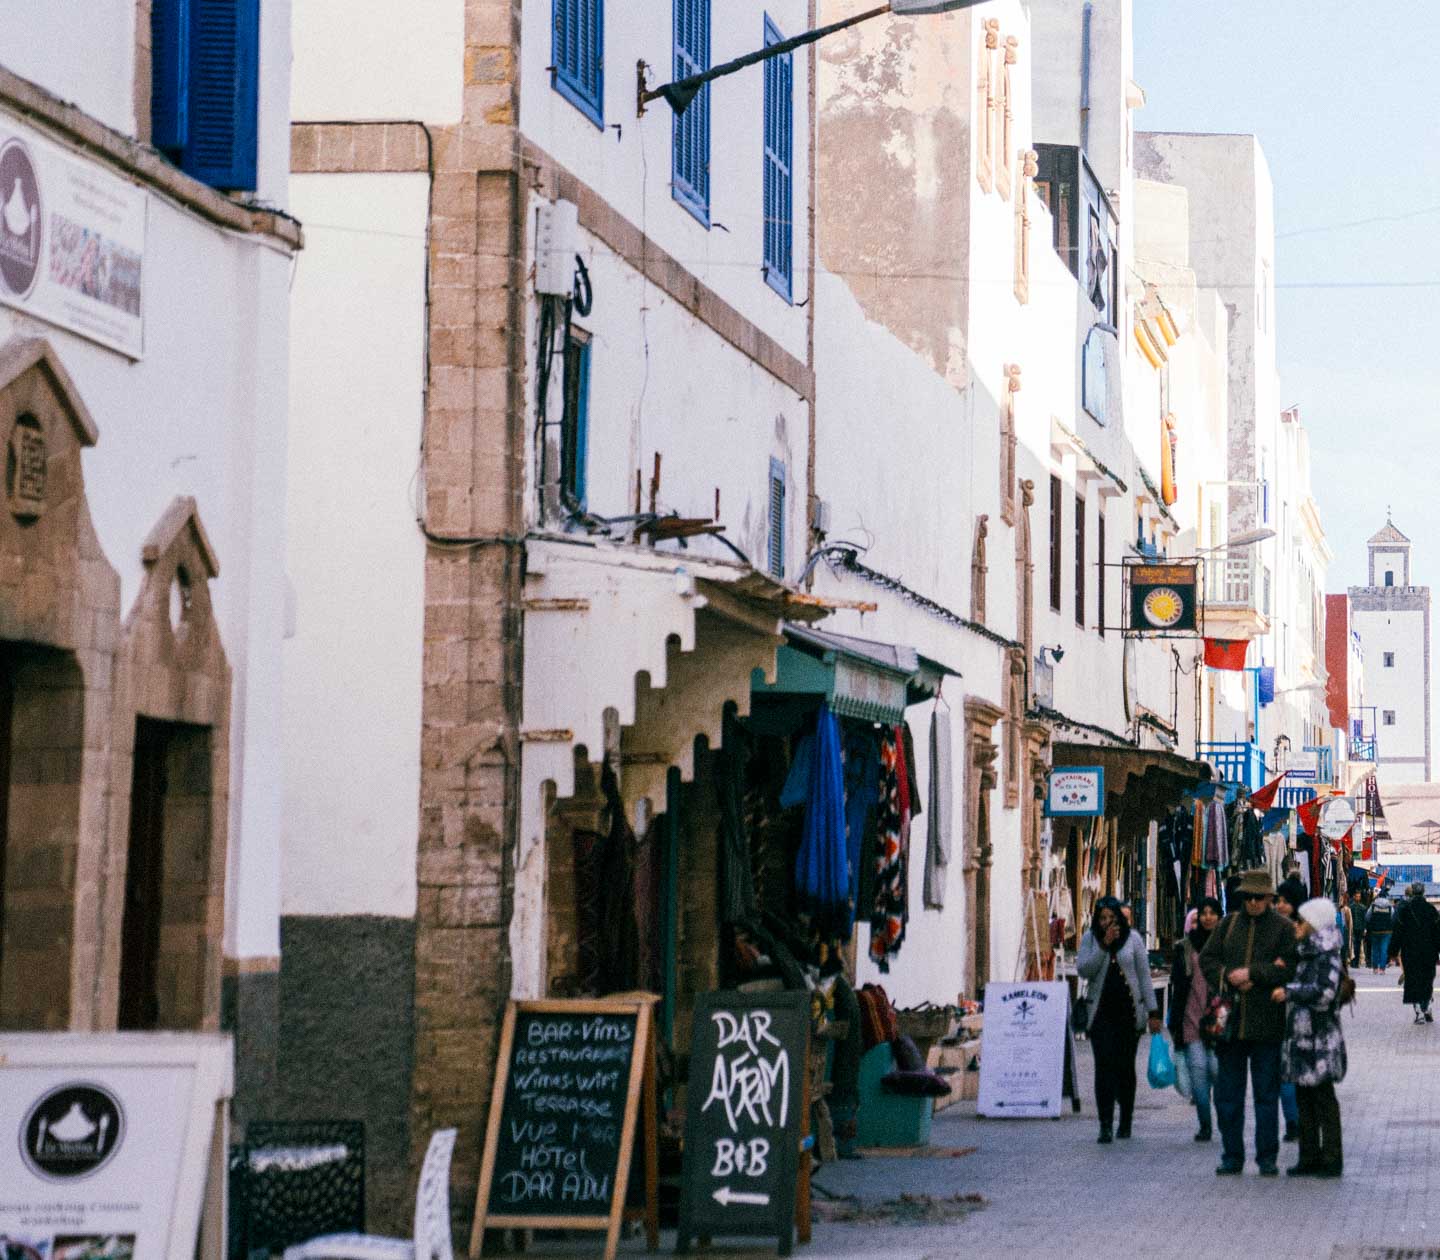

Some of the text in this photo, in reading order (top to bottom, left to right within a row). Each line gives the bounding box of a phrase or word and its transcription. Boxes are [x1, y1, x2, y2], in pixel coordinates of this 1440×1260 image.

[1002, 990, 1048, 1001] KAMELEON
[711, 1010, 781, 1056] DAR
[500, 1170, 555, 1203] DAR
